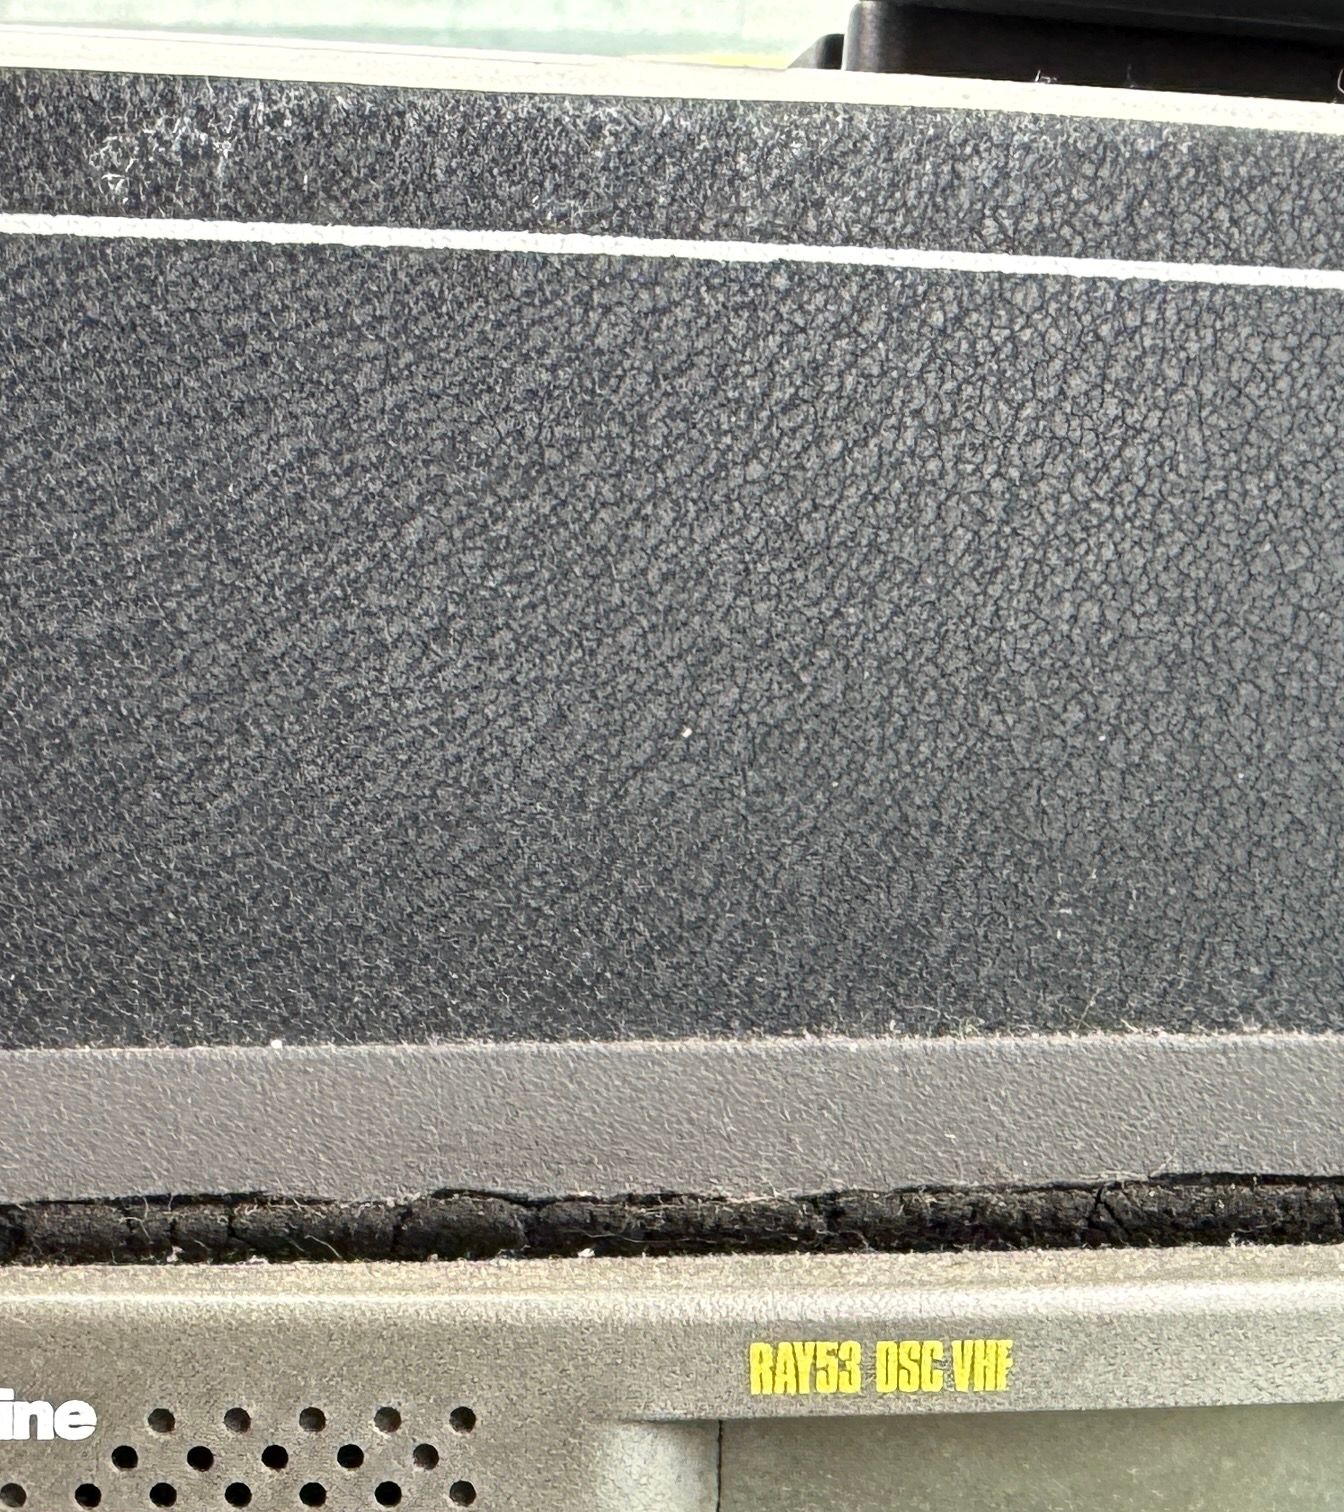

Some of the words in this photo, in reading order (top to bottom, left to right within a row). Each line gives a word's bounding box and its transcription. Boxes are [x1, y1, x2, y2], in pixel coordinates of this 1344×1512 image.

[749, 1340, 861, 1395] RAY53
[875, 1339, 944, 1393] DSC
[950, 1339, 1014, 1392] VHF
